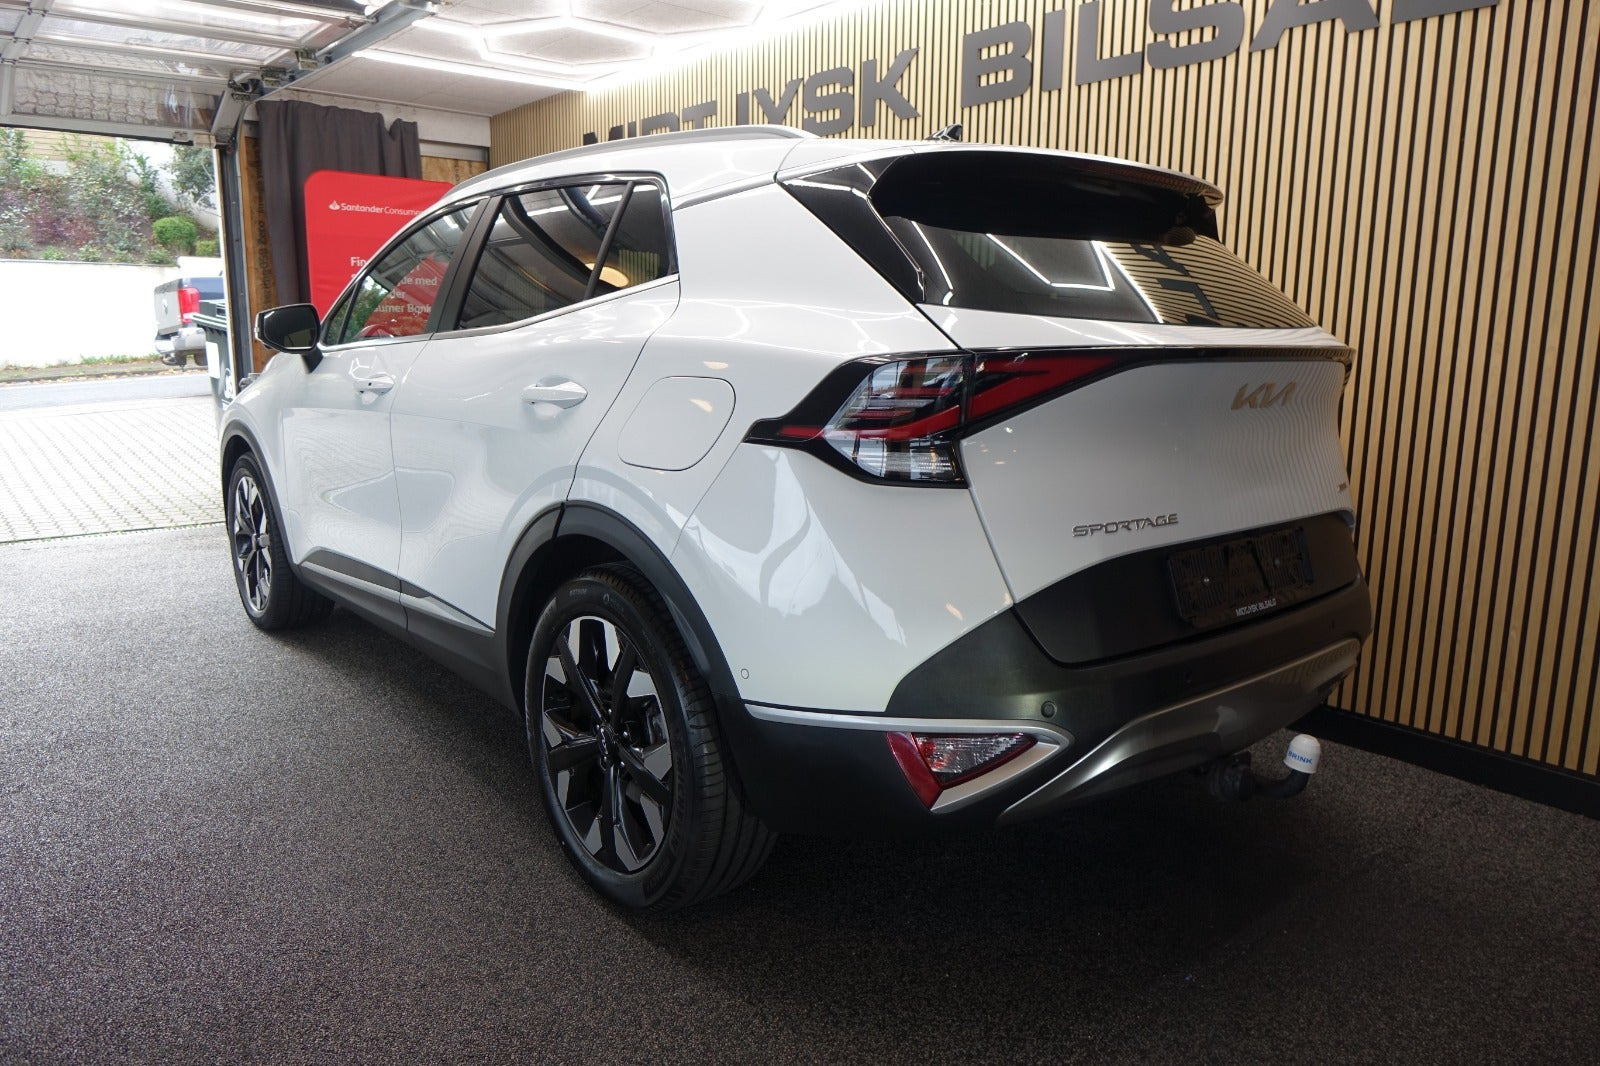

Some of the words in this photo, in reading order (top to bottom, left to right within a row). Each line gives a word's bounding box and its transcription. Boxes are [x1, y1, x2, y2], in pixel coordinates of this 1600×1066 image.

[961, 0, 1501, 109] BILSA
[341, 203, 383, 214] Santander
[384, 206, 421, 216] Consume
[415, 277, 437, 286] med
[1072, 513, 1179, 537] SPORTAGE
[1288, 751, 1312, 764] BRINK
